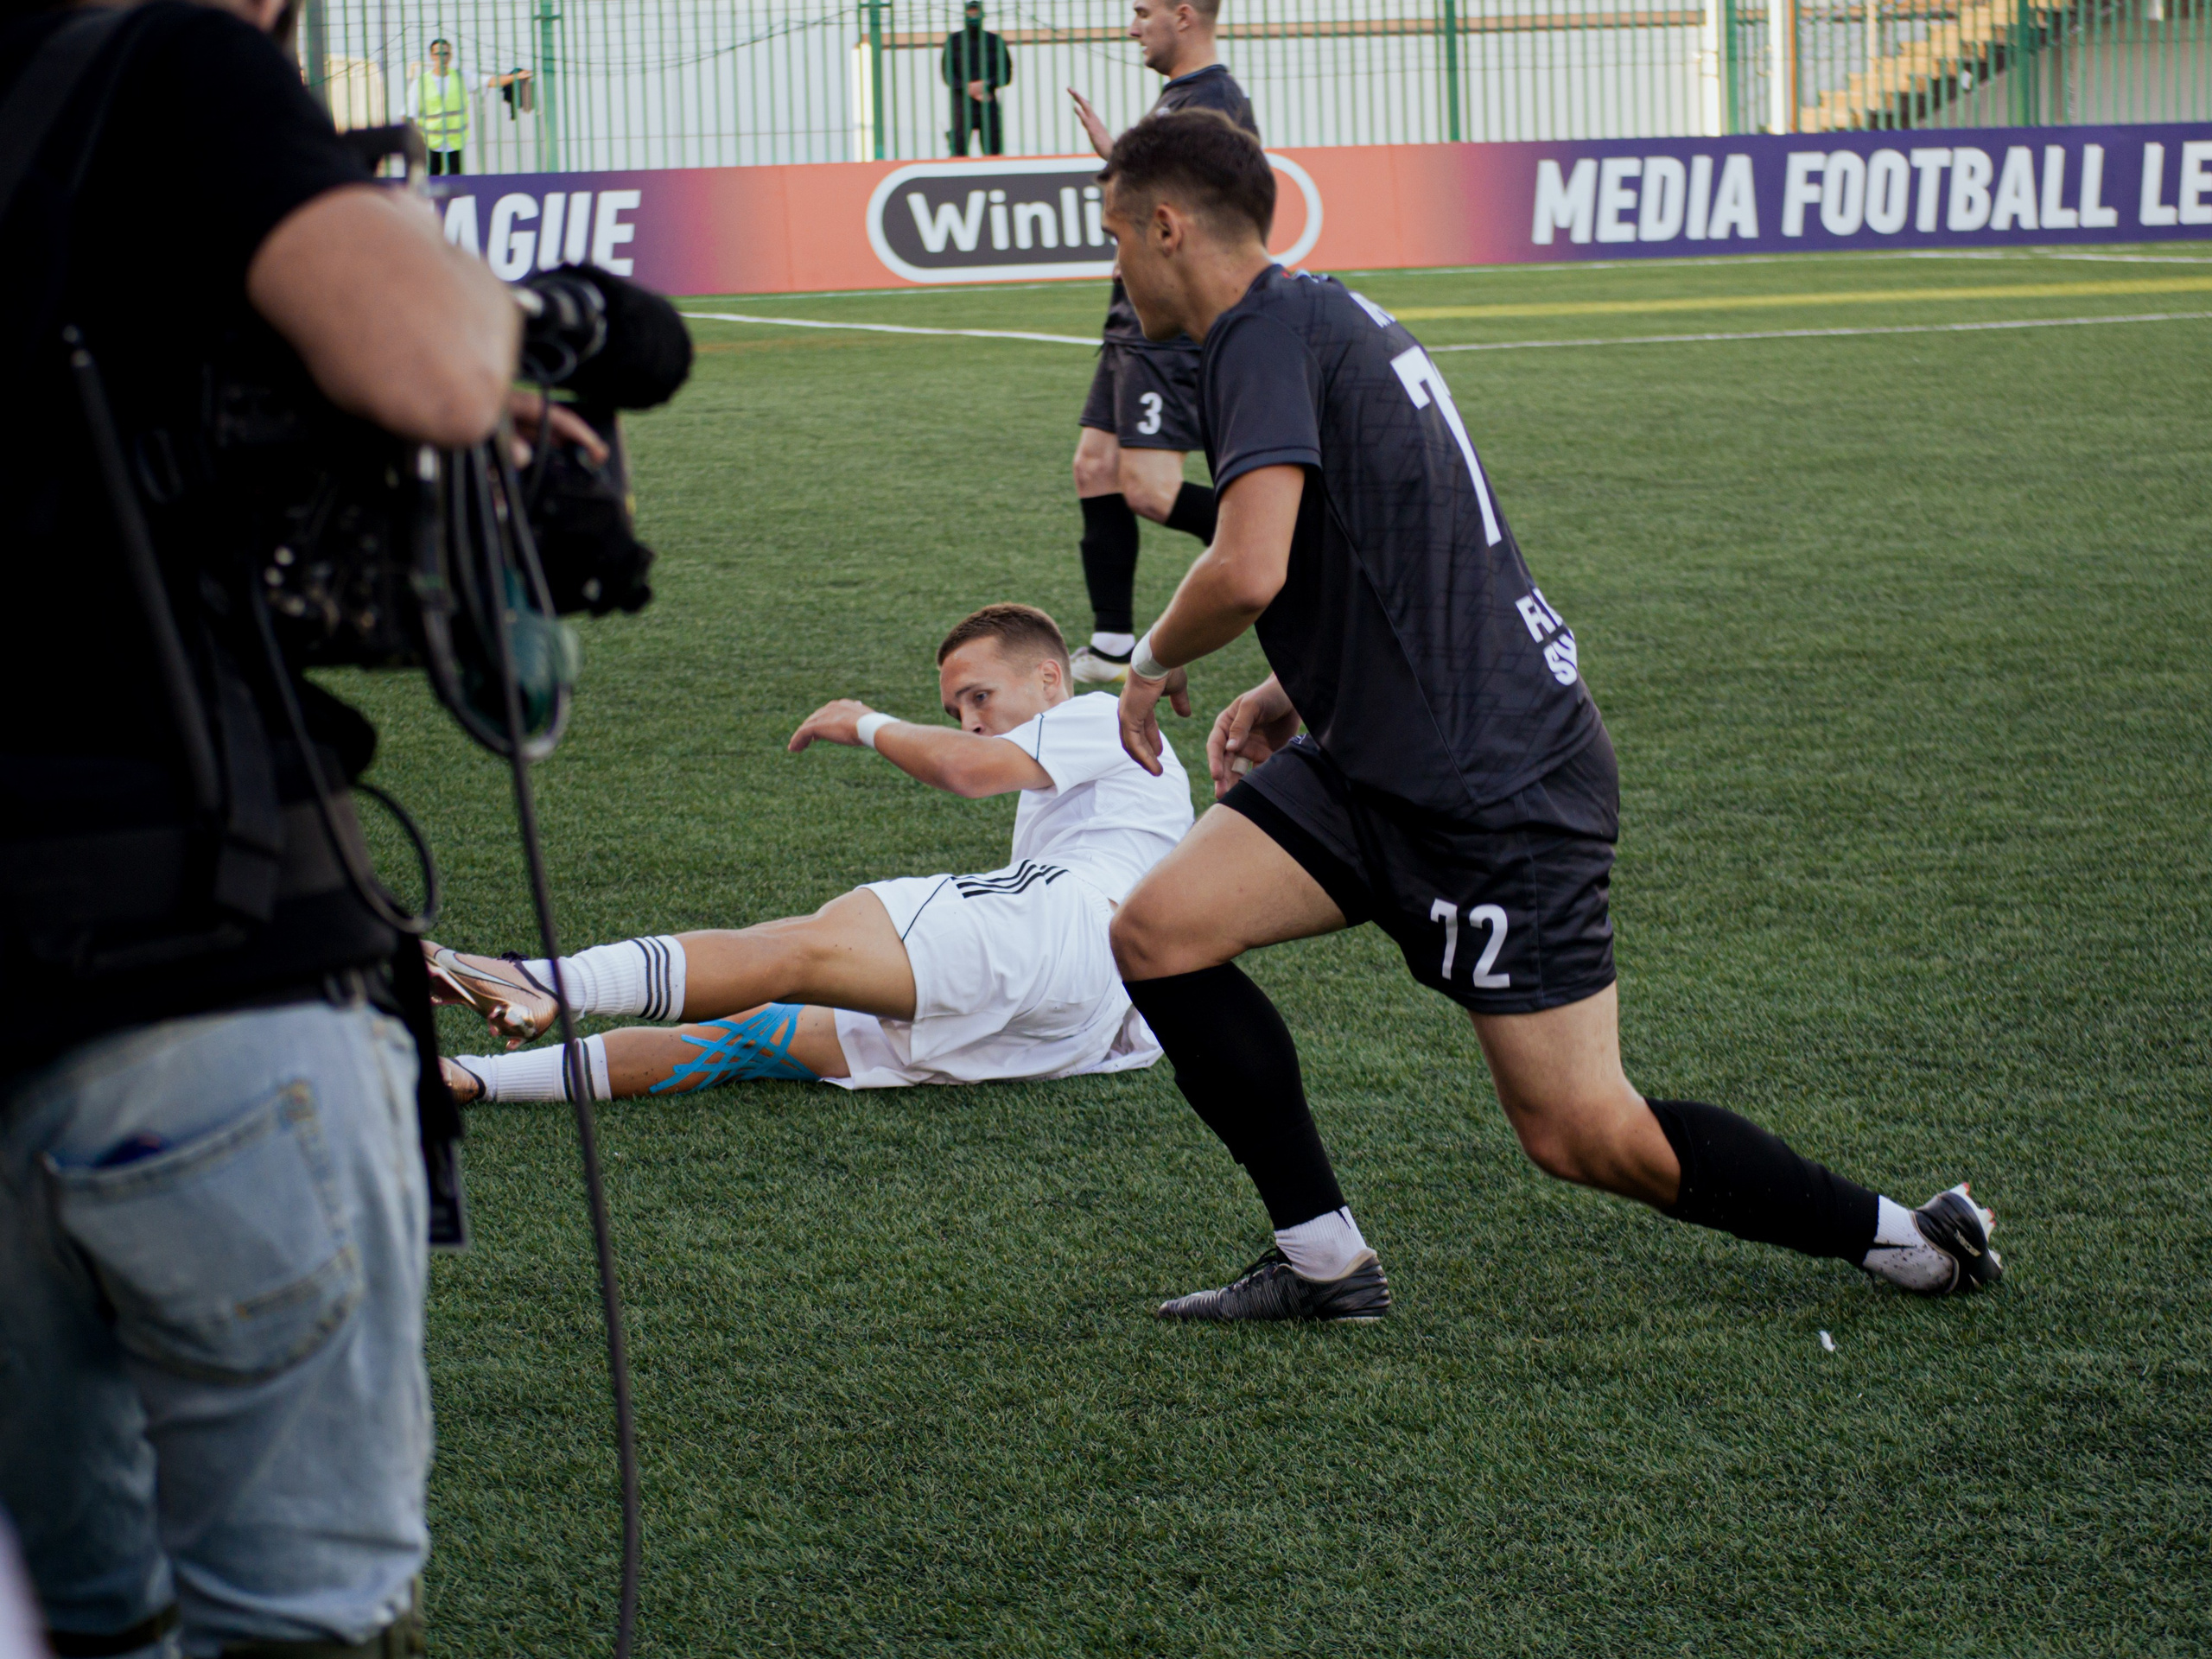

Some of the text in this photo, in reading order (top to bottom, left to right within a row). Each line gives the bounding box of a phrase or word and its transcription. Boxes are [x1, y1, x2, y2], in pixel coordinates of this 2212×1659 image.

[436, 189, 641, 282] AGUE
[906, 185, 1118, 252] Winli
[1531, 154, 1759, 245] MEDIA
[1781, 143, 2119, 238] FOOTBALL
[1136, 391, 1163, 435] 3
[1389, 345, 1503, 548] 7
[1430, 898, 1510, 988] 72
